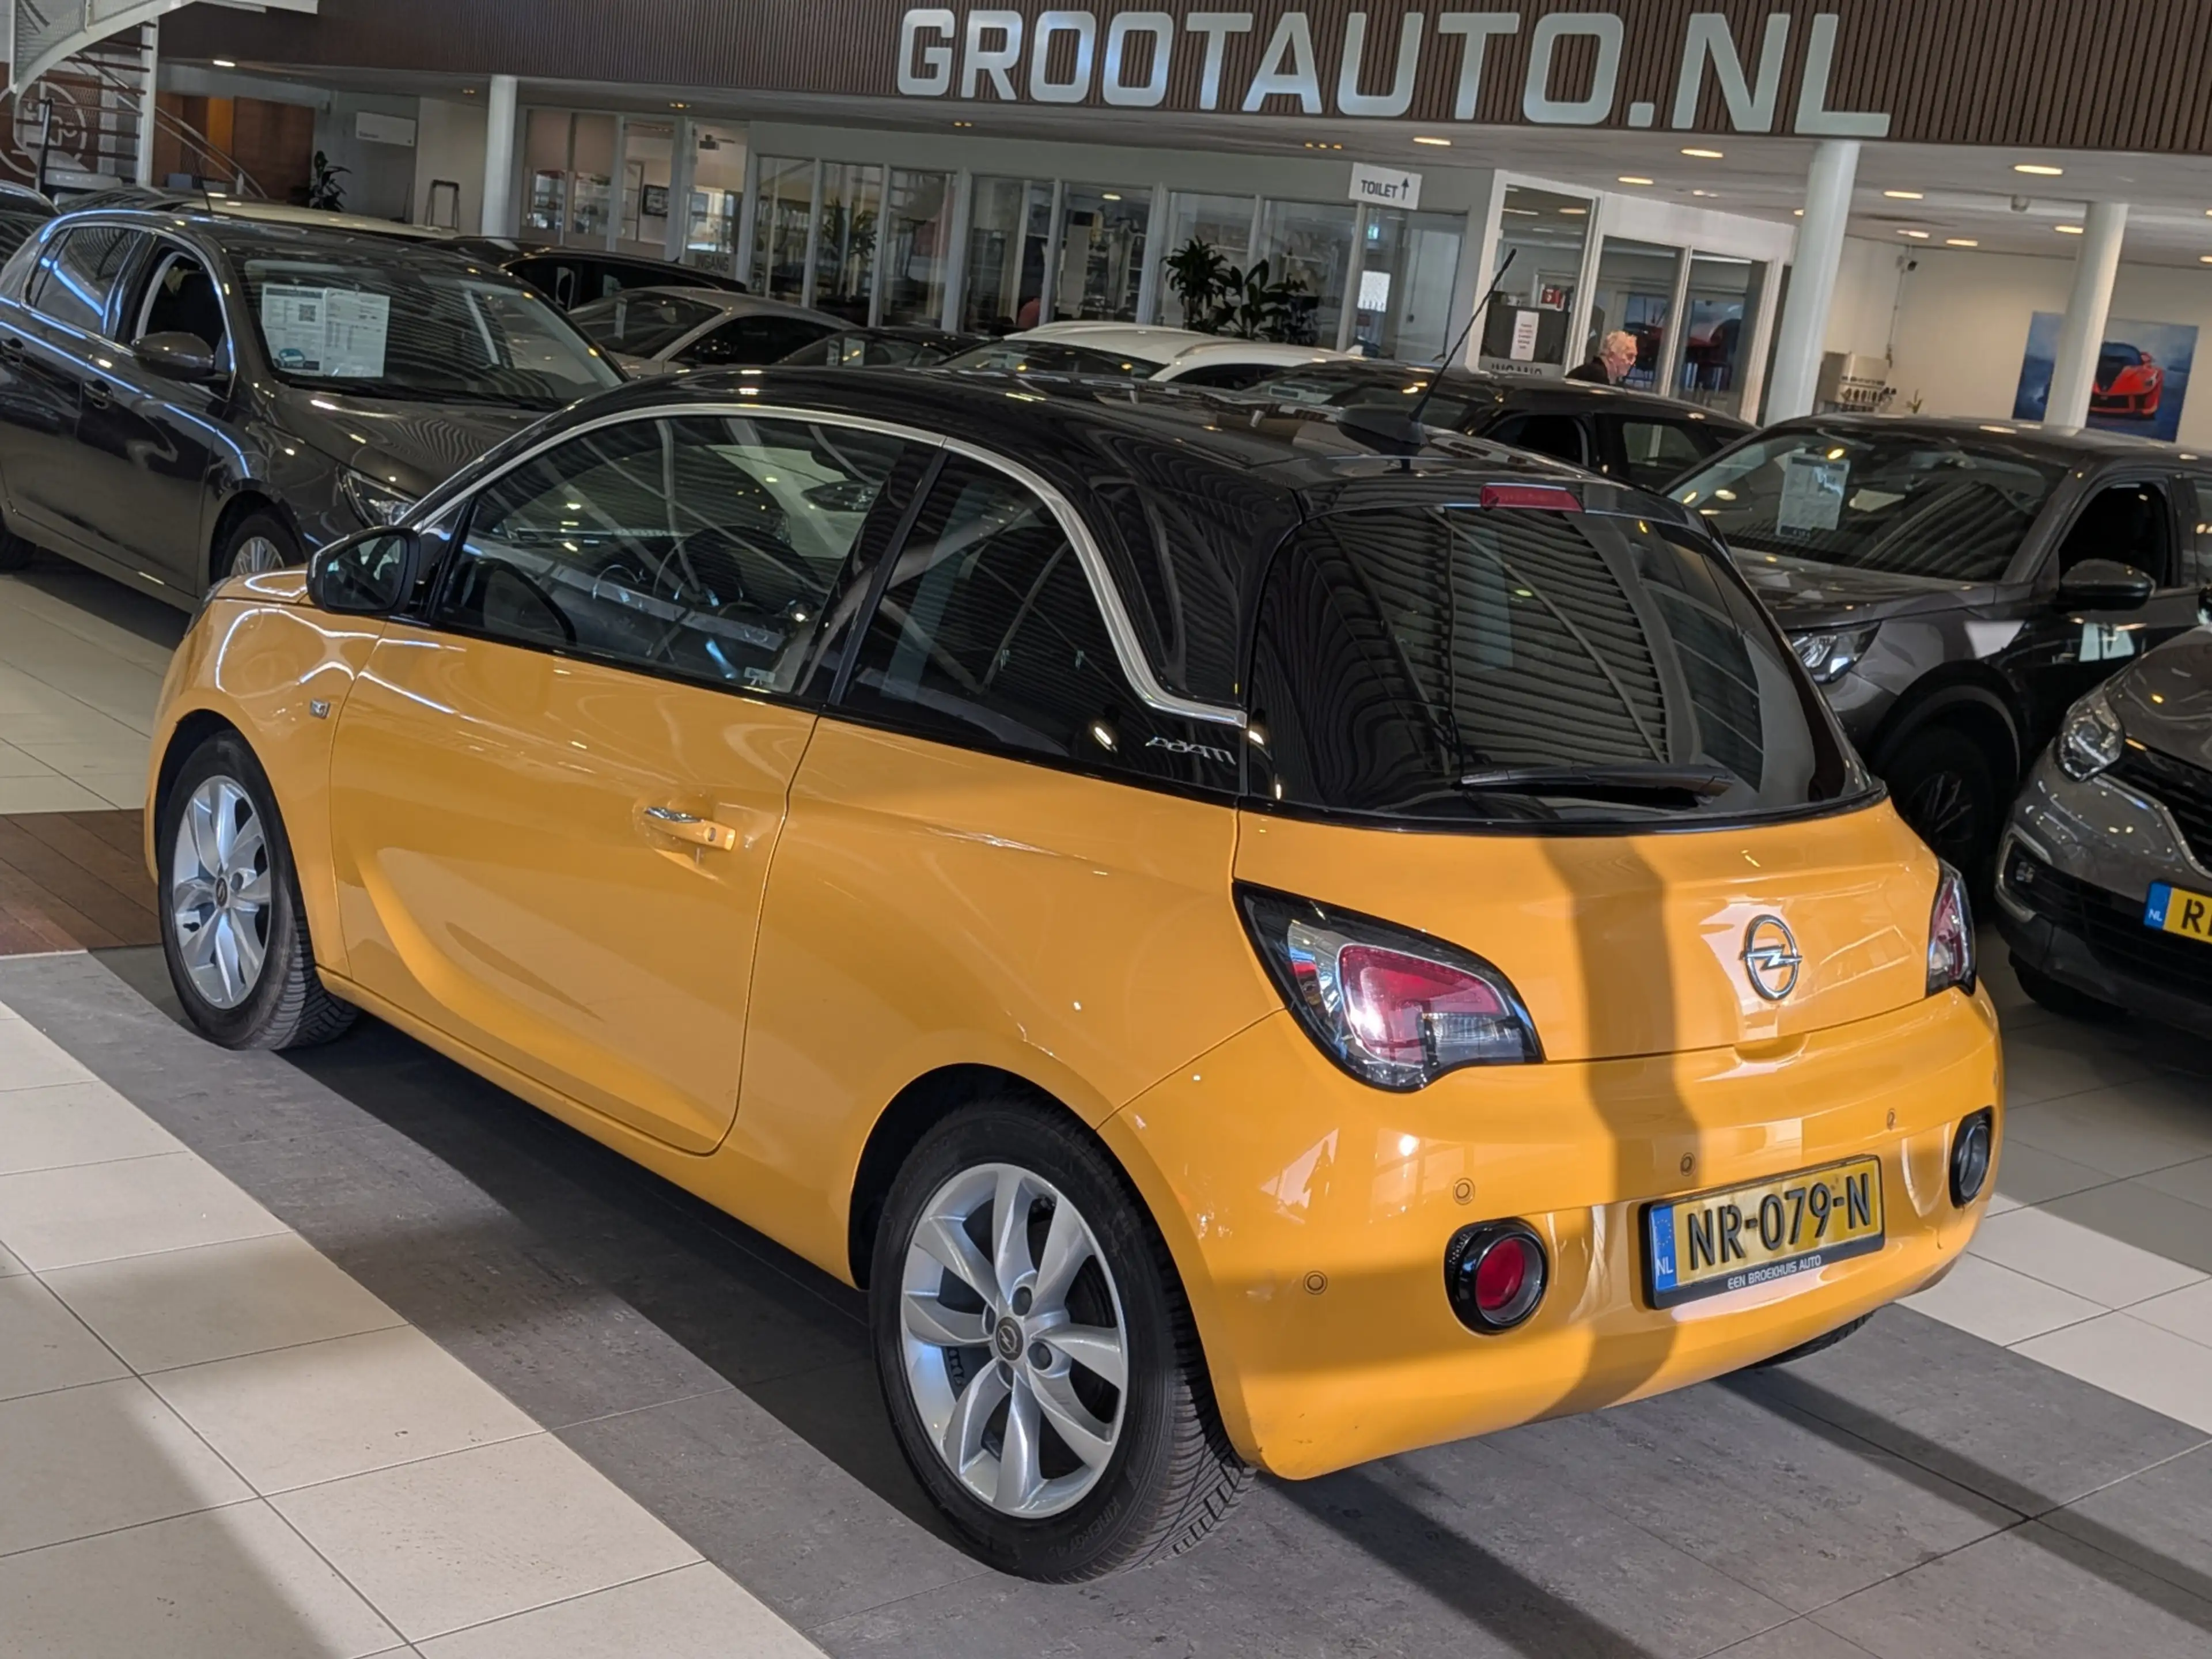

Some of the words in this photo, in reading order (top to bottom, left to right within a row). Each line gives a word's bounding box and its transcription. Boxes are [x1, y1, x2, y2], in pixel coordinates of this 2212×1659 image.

[897, 9, 1891, 138] GROOTAUTO.NL
[1361, 179, 1399, 199] TOILET
[2148, 908, 2163, 922] NL
[1688, 1172, 1870, 1271] NR-079-N
[1656, 1256, 1673, 1277] NL
[1728, 1275, 1746, 1290] EEN
[1748, 1261, 1797, 1285] BROEKHUIS
[1799, 1254, 1822, 1271] AUTO
